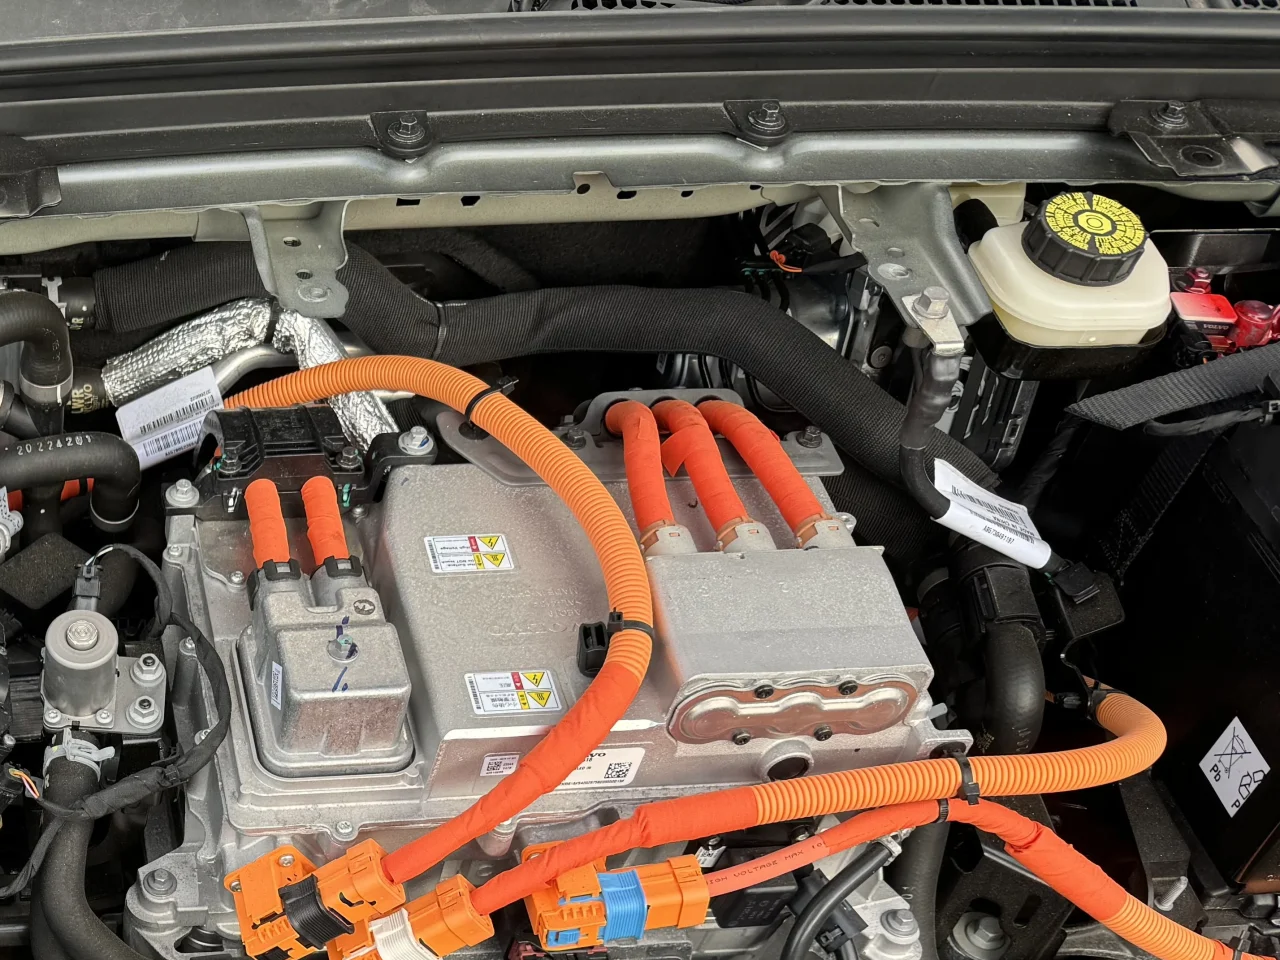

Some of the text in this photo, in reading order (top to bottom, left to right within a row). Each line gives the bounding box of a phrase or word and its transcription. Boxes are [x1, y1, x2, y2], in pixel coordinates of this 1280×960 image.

[1209, 763, 1222, 782] Pb
[733, 860, 778, 878] VOLTAGE
[784, 850, 804, 860] MAX
